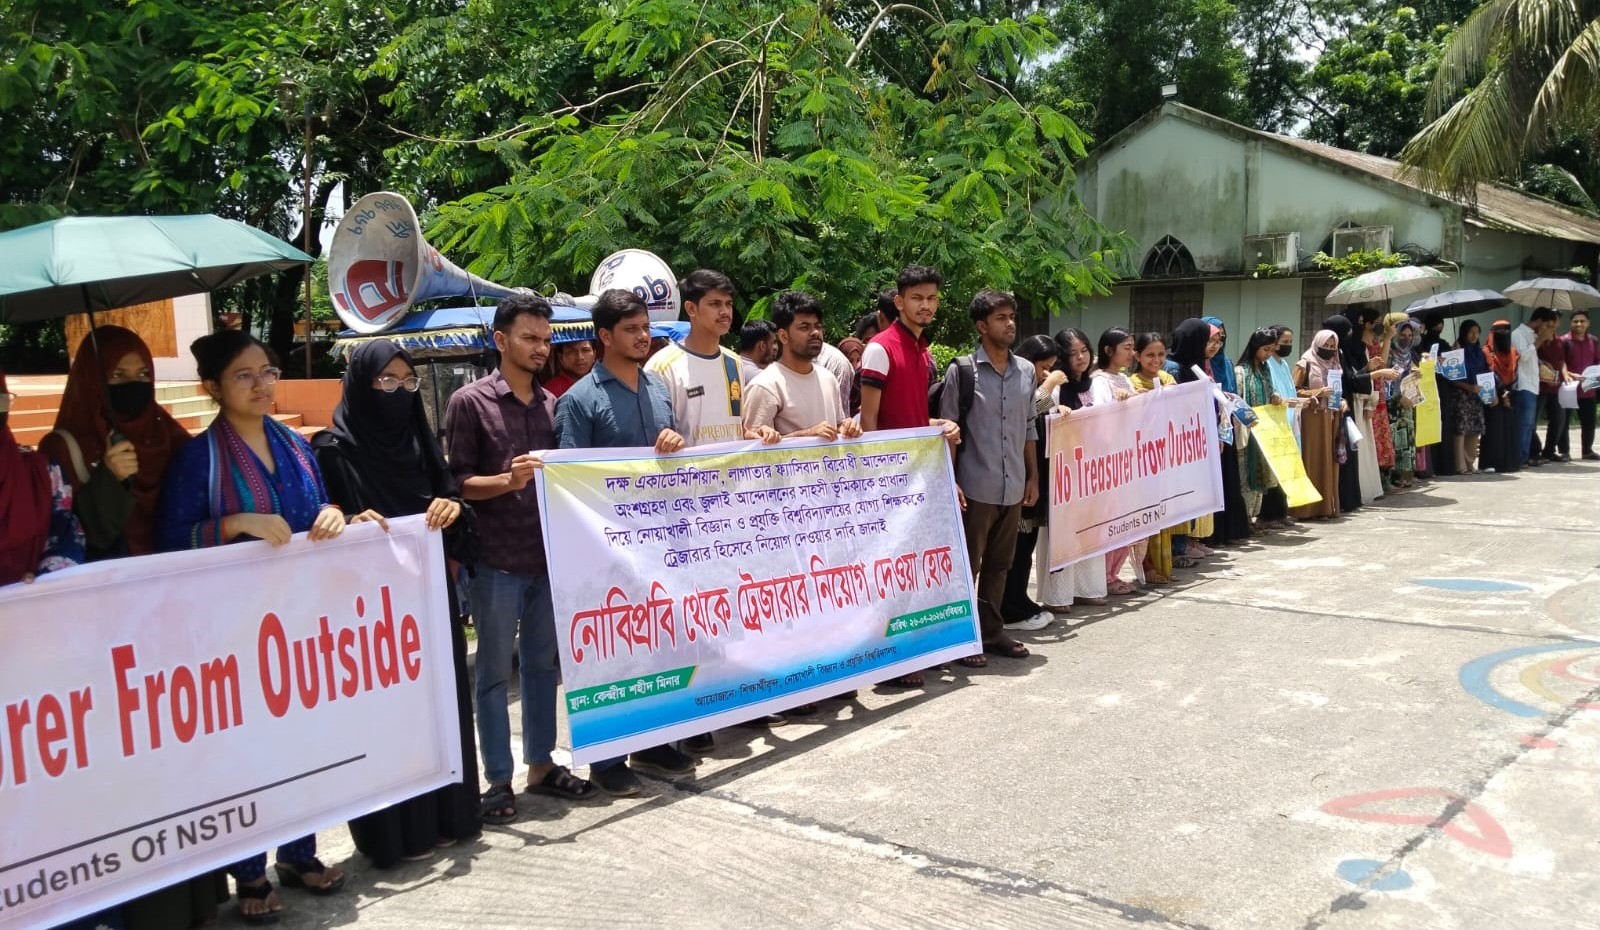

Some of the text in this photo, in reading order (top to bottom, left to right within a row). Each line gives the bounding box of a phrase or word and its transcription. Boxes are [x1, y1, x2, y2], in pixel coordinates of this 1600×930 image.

[605, 477, 631, 493] দক্ষ
[729, 466, 772, 482] লাগাতার
[776, 458, 820, 477] ফ্যাসিবাদ
[823, 452, 857, 472] বিরোধী
[860, 452, 908, 468] আন্দোলনে
[1054, 452, 1071, 505] No
[1075, 448, 1134, 498] Treasurer
[1136, 430, 1166, 478] From
[1168, 412, 1207, 469] Outside
[605, 492, 925, 547] দিয়ে নোয়াখালী বিজ্ঞান ও প্রযুক্তি বিশ্ববিদ্যালয়ের যোগ্য শিক্ষককে
[614, 474, 908, 519] অংশগ্রহণ এবং জুলাই আন্দোলনের সাহসী ভূমিকাকে প্রাধান্য
[664, 518, 888, 567] ট্রেজারার হিসেবে নিয়োগ দেওয়ার দাবি জানাই
[1108, 518, 1140, 537] Students
[1142, 513, 1152, 524] Of
[570, 546, 952, 664] নোবিপ্রবি থেকে ট্রেজারার নিয়োগ দেওয়া হোক
[112, 644, 243, 757] From
[258, 585, 422, 718] Outside
[593, 685, 626, 704] কেন্দ্রীয়
[629, 680, 653, 696] শহীদ
[656, 675, 680, 690] মিনার
[784, 666, 815, 685] নোয়াখালী
[817, 663, 838, 674] বিজ্ঞান
[132, 832, 166, 863] Of
[177, 801, 258, 851] NSTU
